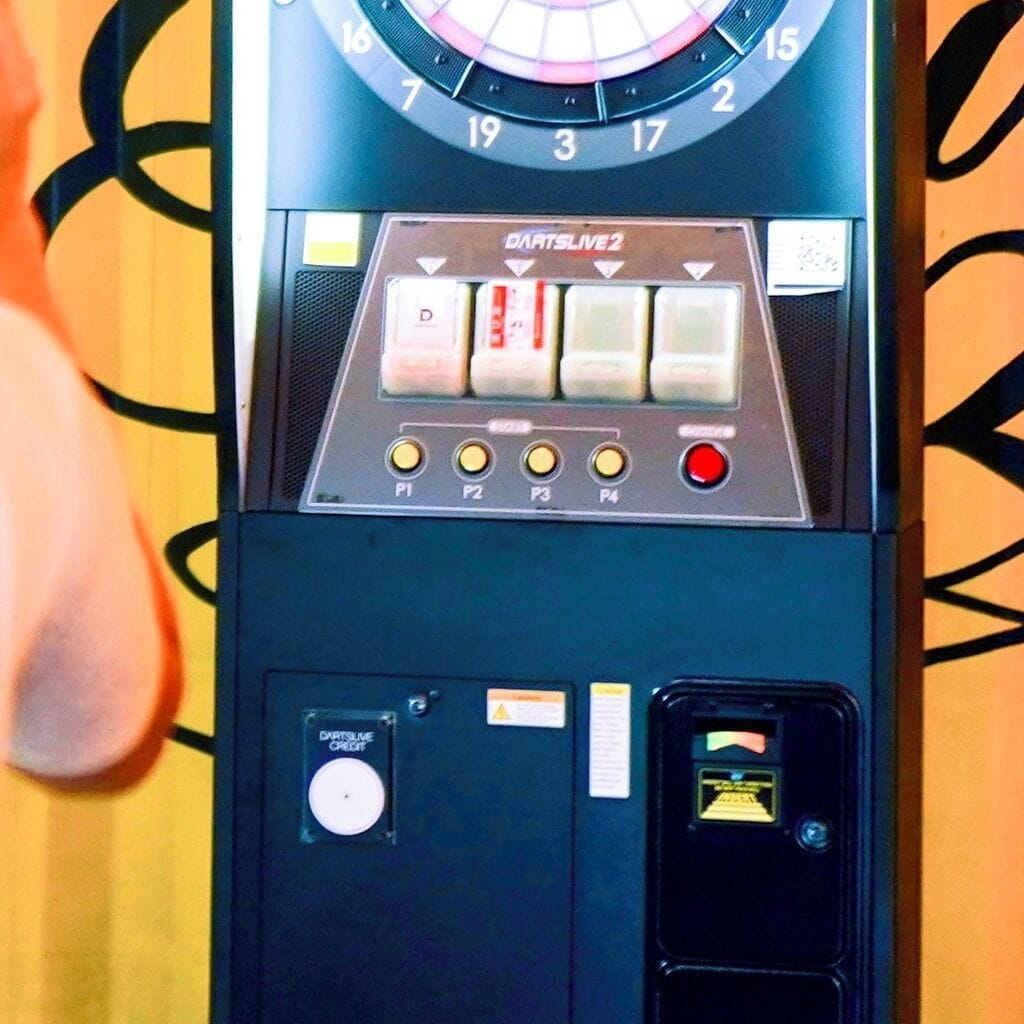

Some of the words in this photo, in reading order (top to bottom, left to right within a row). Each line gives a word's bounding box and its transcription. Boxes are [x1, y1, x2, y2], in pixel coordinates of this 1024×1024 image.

[341, 21, 373, 54] 16
[764, 27, 800, 61] 15
[400, 78, 424, 112] 7
[711, 79, 735, 112] 2
[467, 115, 502, 148] 19
[553, 128, 576, 161] 3
[629, 119, 670, 153] 17
[420, 308, 433, 322] D
[395, 482, 413, 497] P1
[462, 484, 483, 500] P2
[530, 486, 551, 502] P3
[599, 488, 619, 504] P4
